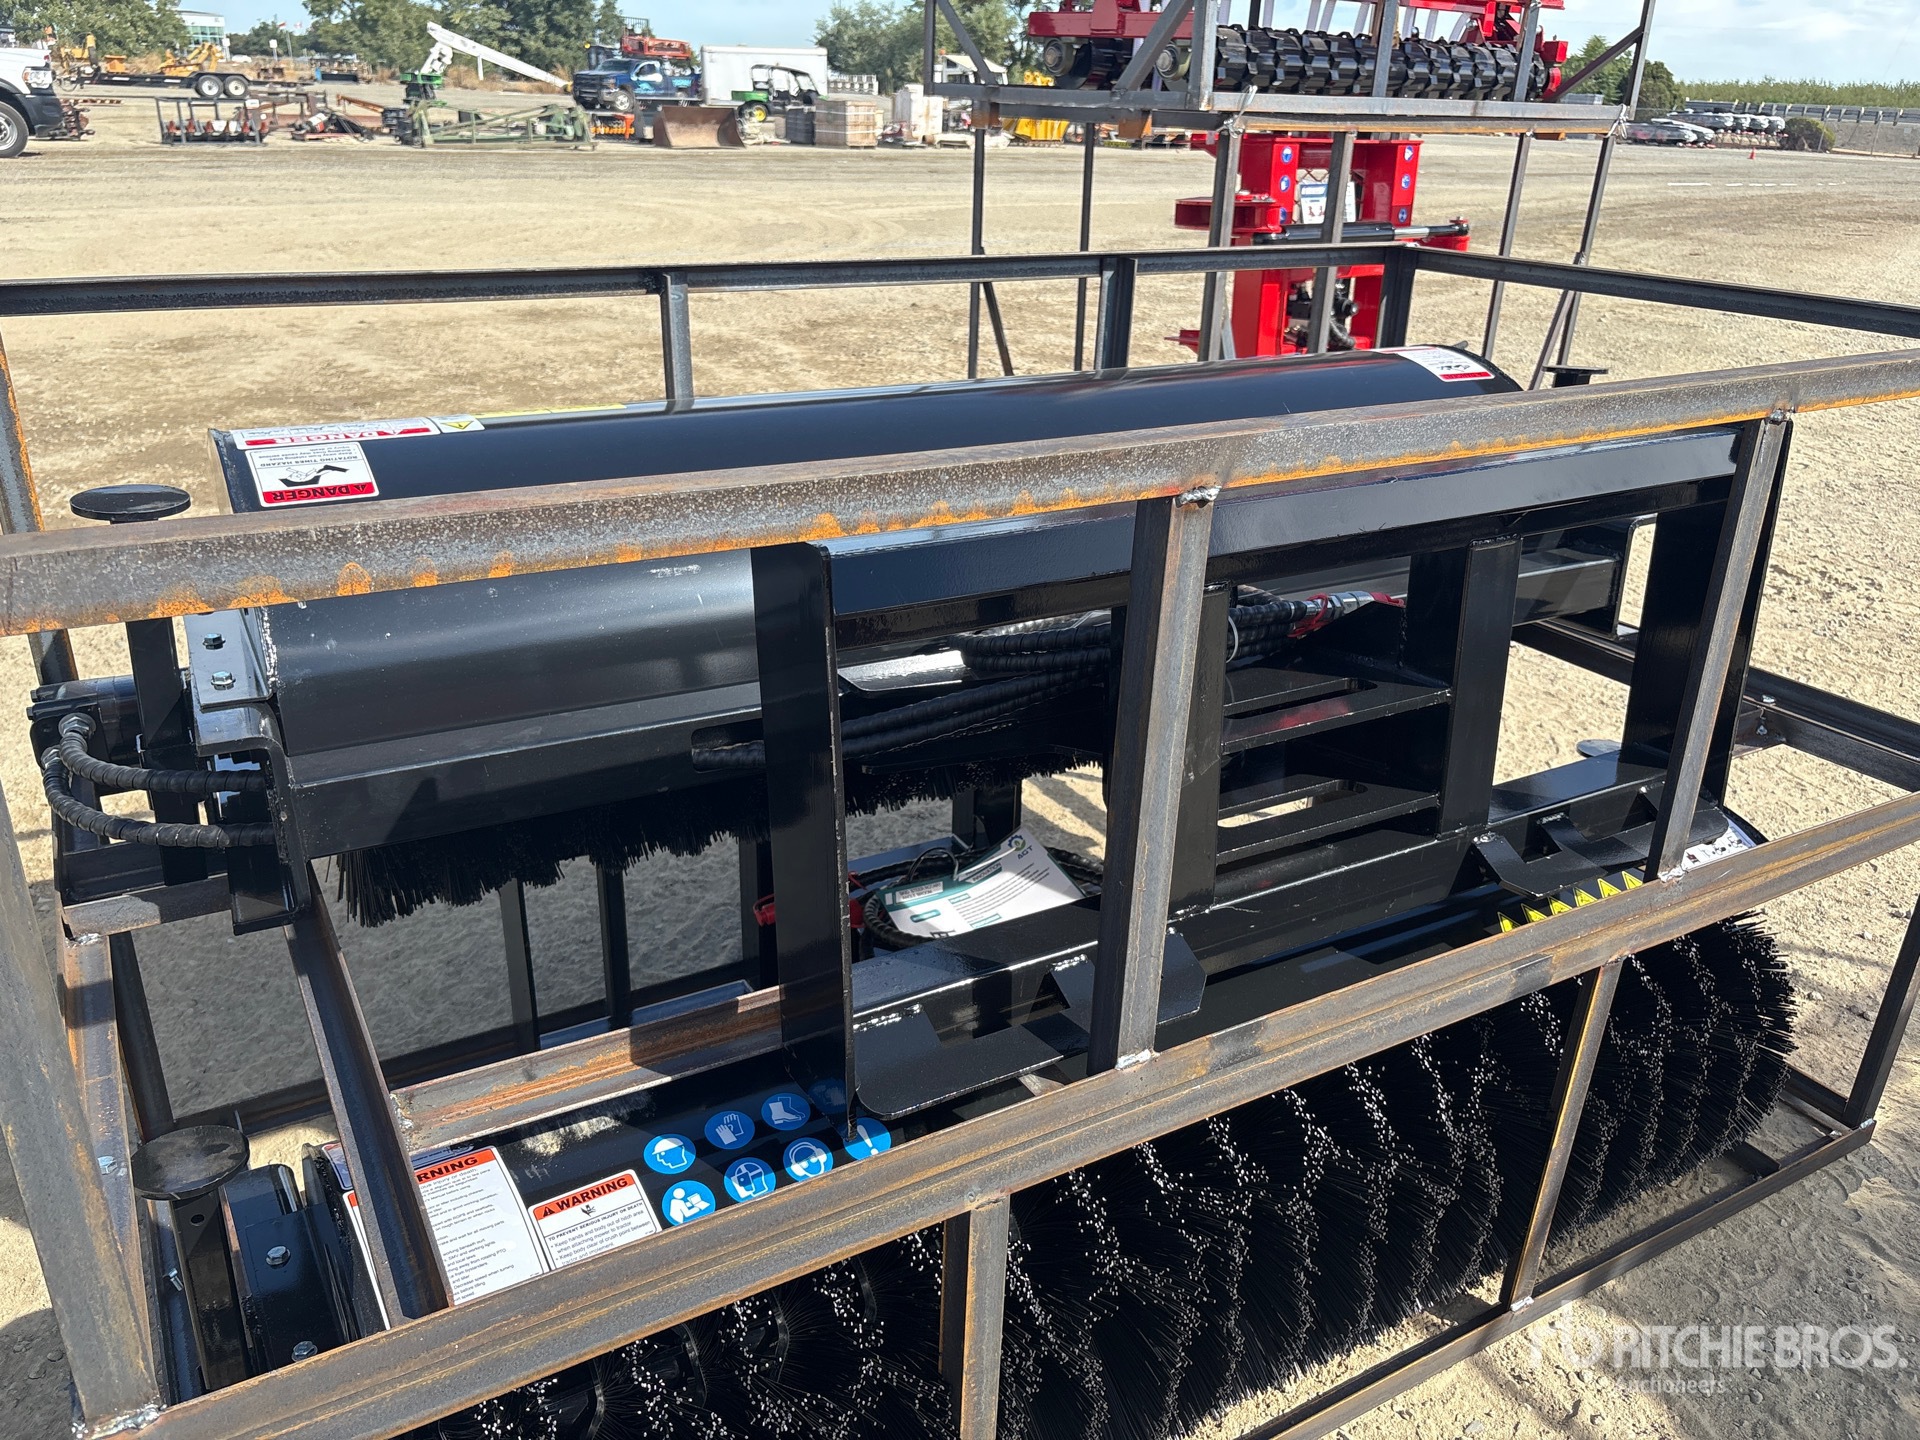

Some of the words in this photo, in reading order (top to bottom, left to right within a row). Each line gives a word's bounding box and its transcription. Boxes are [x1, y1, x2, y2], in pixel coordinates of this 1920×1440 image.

[272, 485, 350, 501] DANGER
[1017, 844, 1033, 860] AGT
[416, 1156, 478, 1182] RNING
[432, 1177, 450, 1185] injury
[556, 1177, 628, 1211] WARNING
[556, 1226, 579, 1238] PREVENT
[579, 1218, 600, 1229] SERIOUS
[600, 1211, 618, 1220] INJURY
[627, 1201, 643, 1210] DEATH
[567, 1234, 583, 1242] hands
[620, 1213, 632, 1221] hitch
[557, 1246, 570, 1254] when
[571, 1237, 593, 1248] attaching
[593, 1229, 610, 1239] mower
[615, 1221, 631, 1230] tractor
[604, 1232, 618, 1241] crush
[618, 1227, 630, 1236] point
[630, 1220, 650, 1231] between
[442, 1248, 459, 1256] working
[464, 1262, 487, 1272] bystanders
[453, 1280, 474, 1289] Decrease
